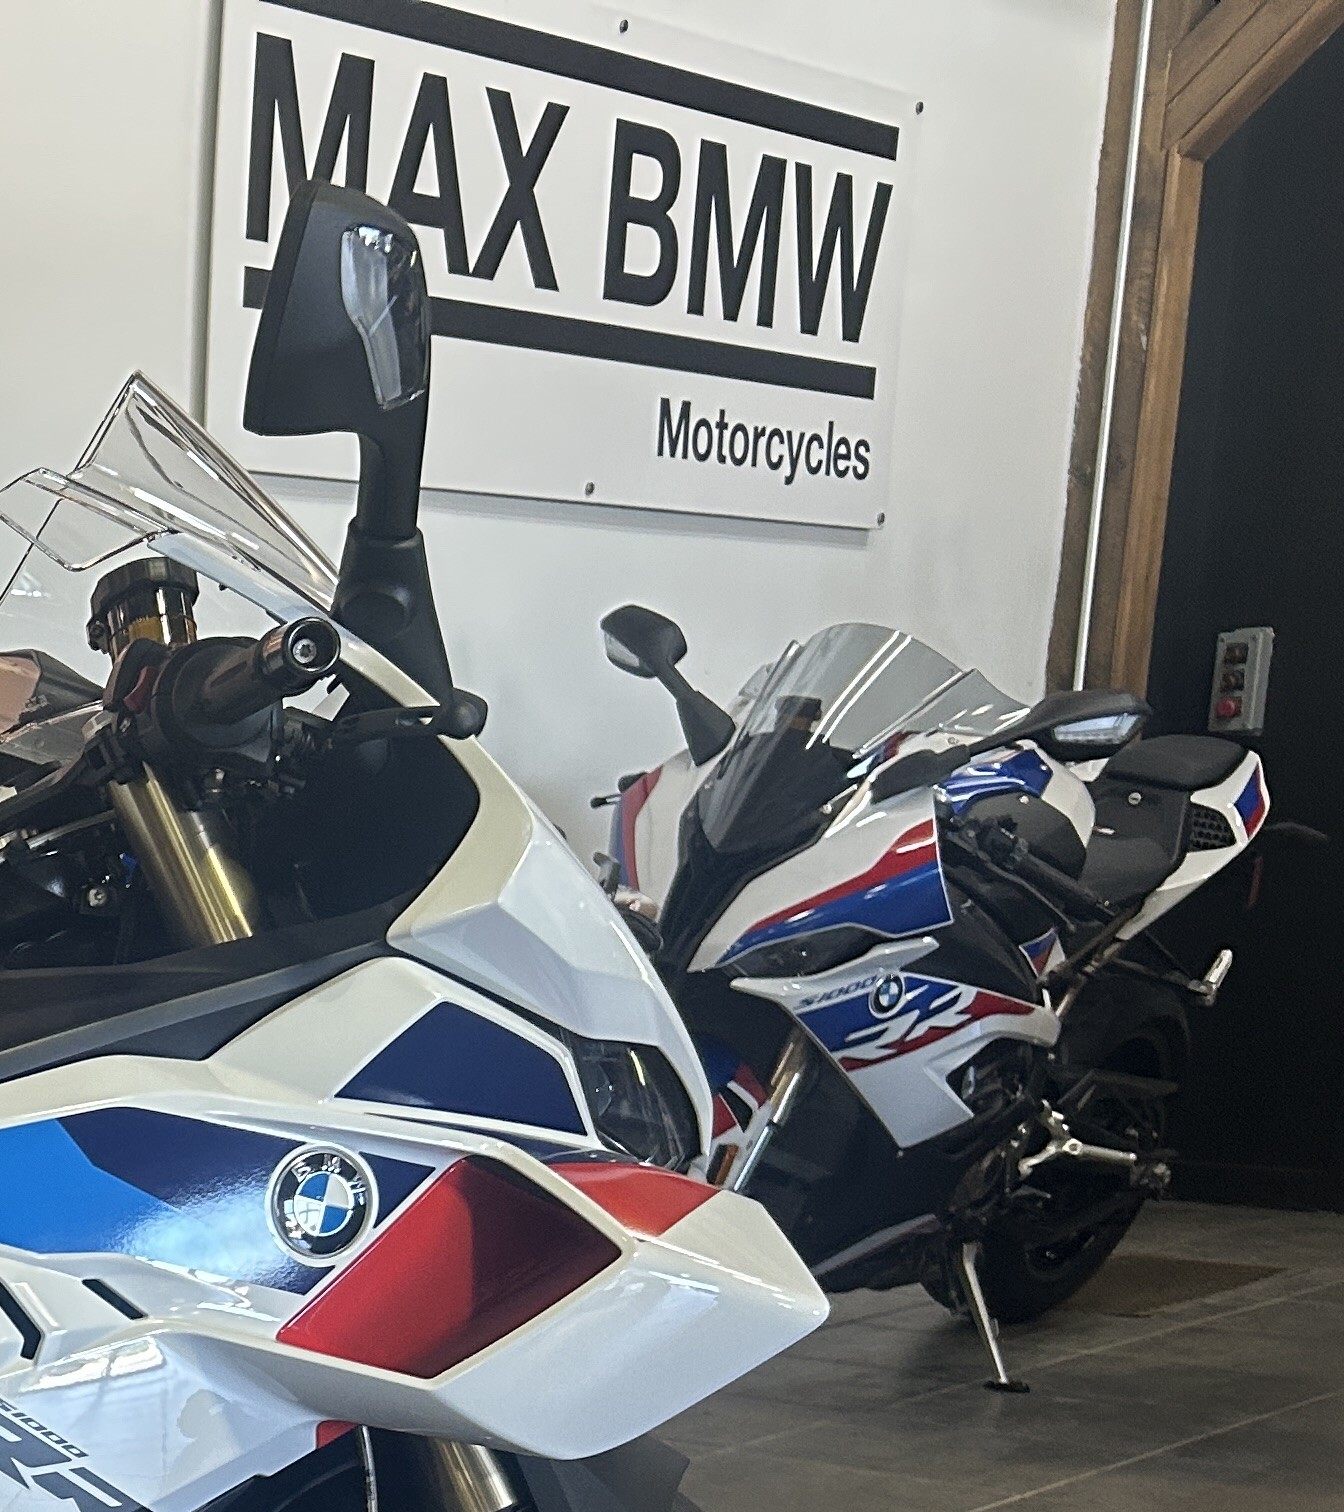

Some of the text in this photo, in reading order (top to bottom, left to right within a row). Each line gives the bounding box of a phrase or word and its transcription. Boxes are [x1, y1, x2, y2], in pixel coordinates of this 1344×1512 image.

[245, 32, 894, 343] MAX BMW
[657, 397, 872, 485] Motorcycles
